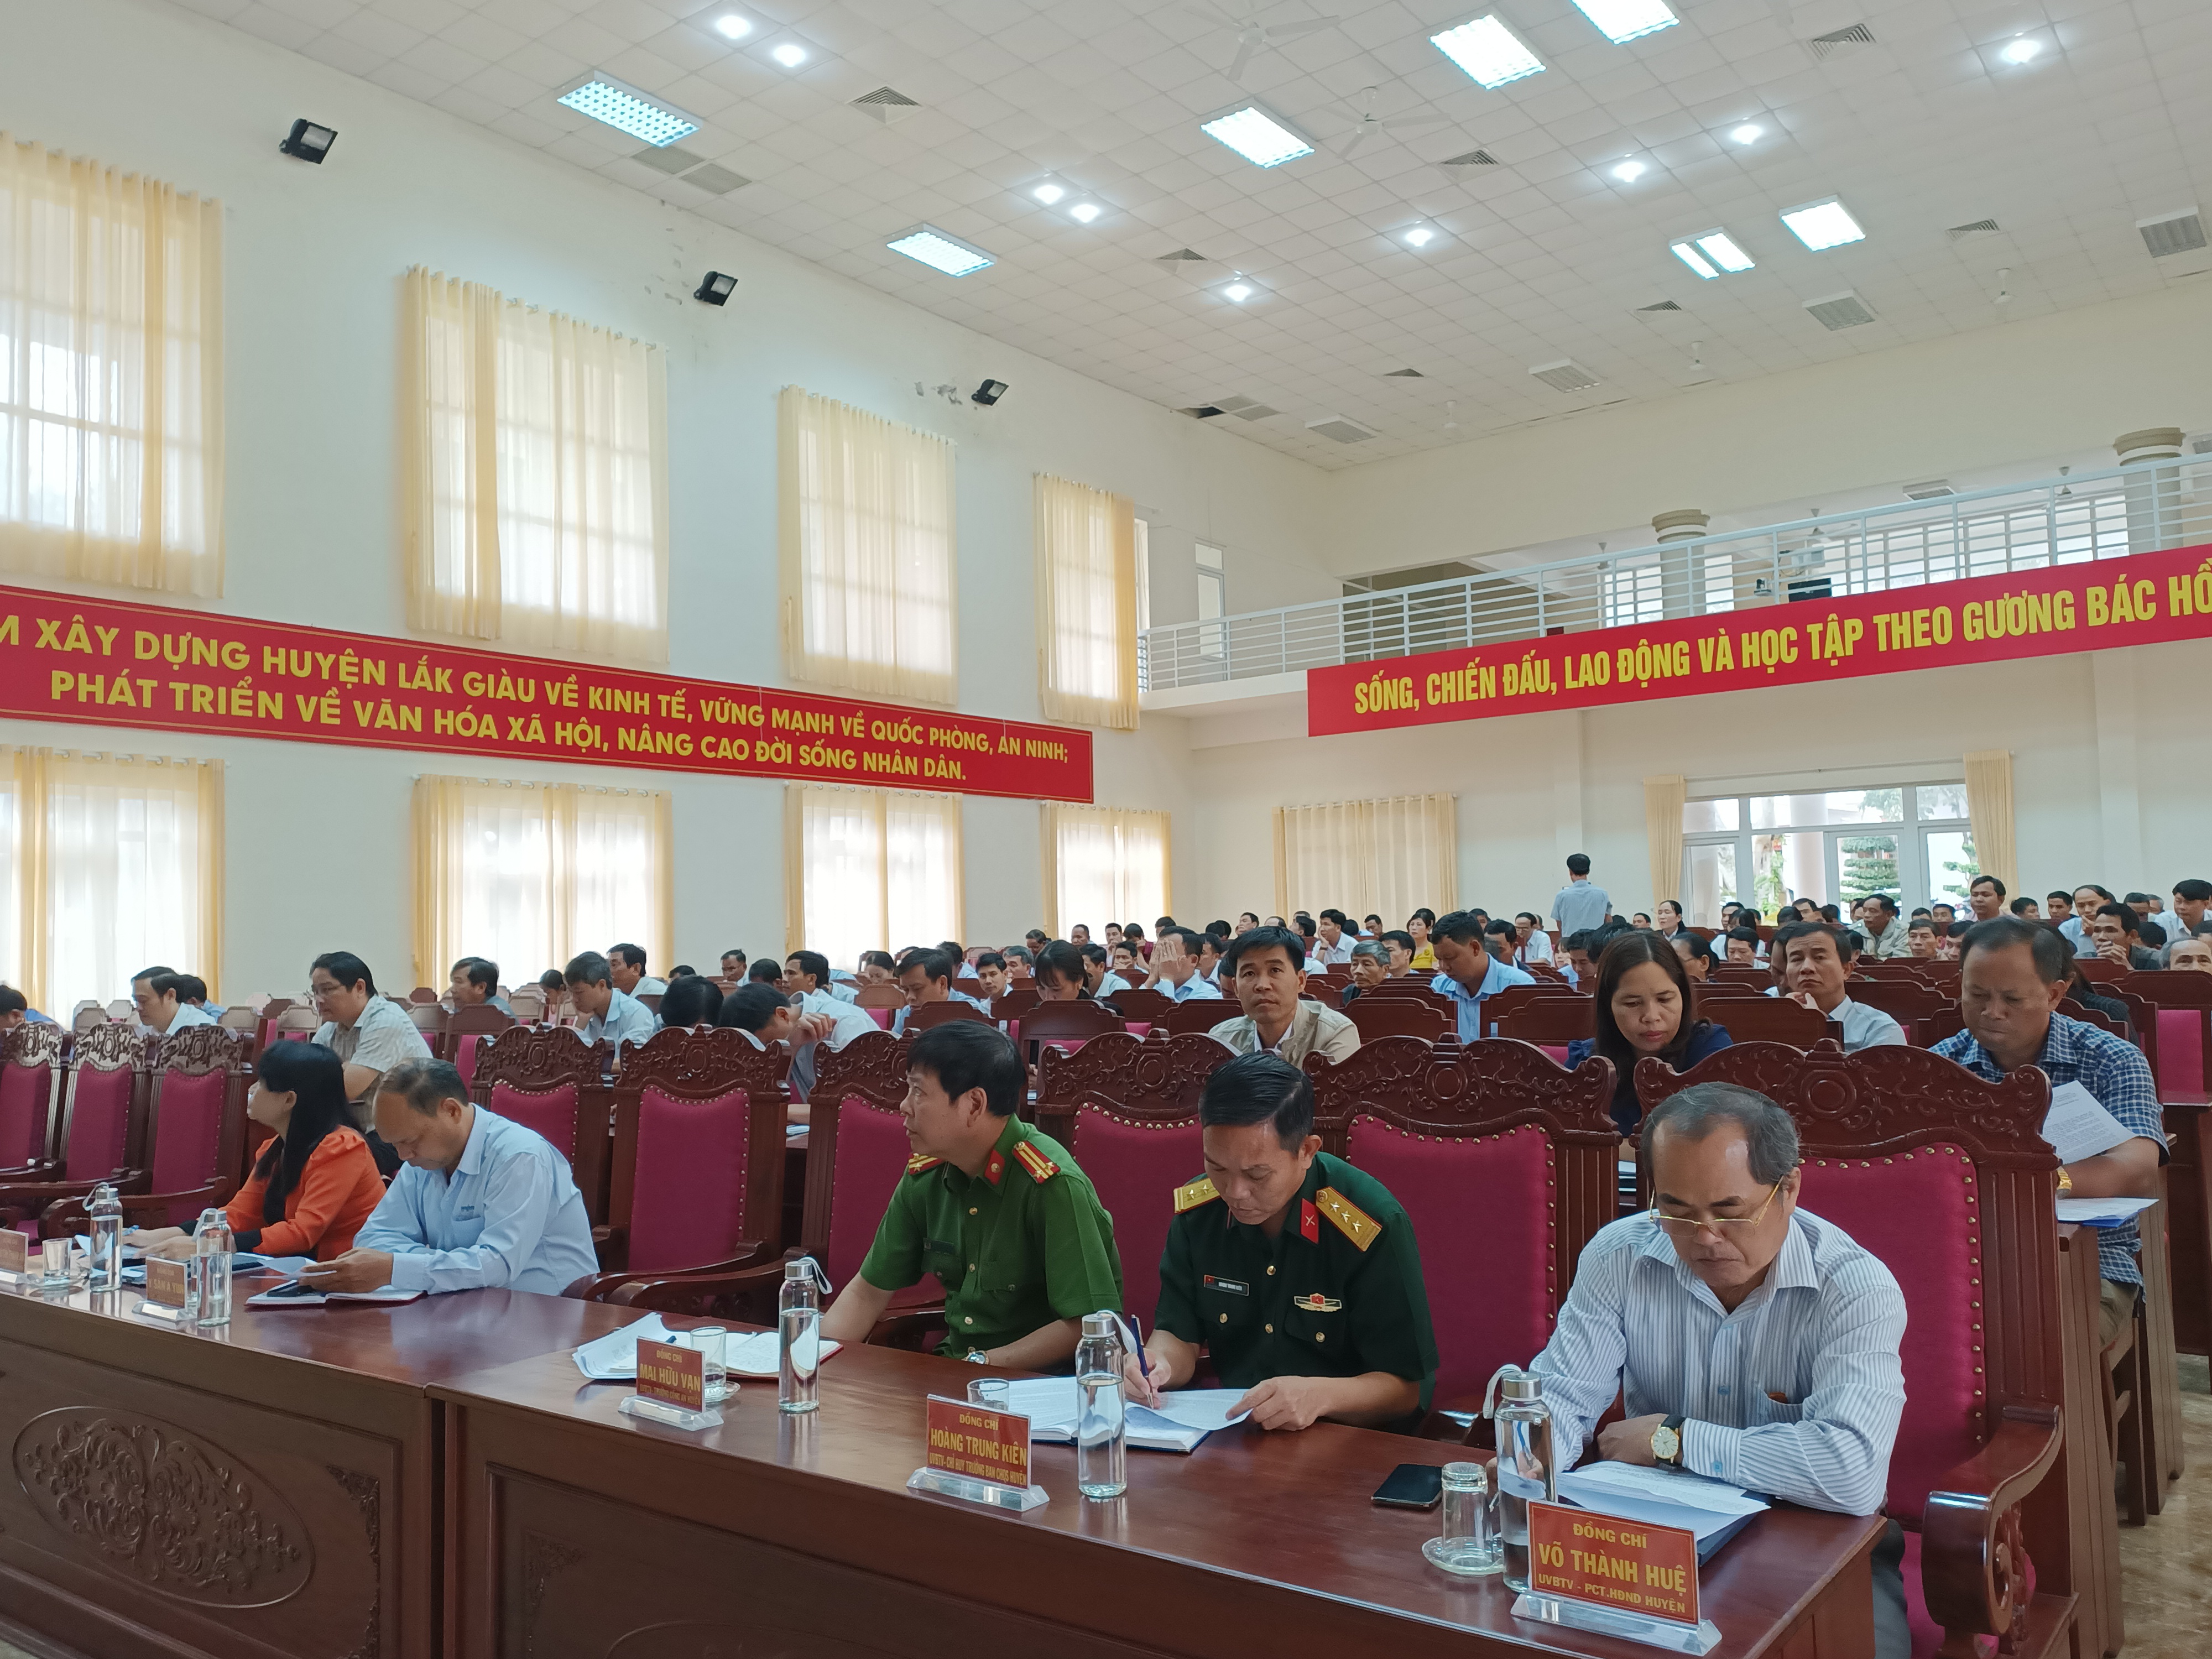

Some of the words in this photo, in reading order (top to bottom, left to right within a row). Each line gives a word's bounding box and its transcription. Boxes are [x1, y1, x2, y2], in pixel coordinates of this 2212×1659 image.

[1355, 671, 1419, 713] SỐNG,
[1427, 658, 1495, 705] CHIẾN
[1503, 650, 1557, 696] ĐẤU,
[1565, 651, 1610, 688] LAO
[1617, 639, 1689, 687] ĐỘNG
[1698, 629, 1734, 672] VÀ
[1741, 627, 1798, 673] HỌC
[1807, 614, 1863, 666] TẬP
[1873, 606, 1952, 651] THEO
[1963, 591, 2075, 641] GƯƠNG
[2086, 575, 2156, 626] BÁC
[2168, 557, 2212, 617] HỒ
[35, 614, 119, 656] XÂY
[135, 632, 249, 670] DỰNG
[264, 646, 385, 689] HUYỆN
[399, 656, 452, 693] LẮK
[463, 668, 535, 702] GIÀU
[545, 675, 578, 707] VỀ
[589, 687, 649, 714] KINH
[658, 688, 692, 722] TẾ,
[700, 697, 764, 726] VỮNG
[772, 708, 834, 737] MẠNH
[841, 712, 864, 737] VỀ
[872, 717, 924, 744] QUỐC
[930, 724, 993, 755] PHÒNG,
[998, 736, 1020, 755] AN
[1025, 739, 1068, 763] NINH;
[52, 669, 158, 708] PHÁT
[169, 676, 285, 720] TRIỂN
[296, 688, 340, 724] VỀ
[353, 699, 421, 732] VĂN
[435, 705, 498, 739] HÓA
[508, 714, 545, 743] XÃ
[555, 717, 608, 752] HỘI,
[618, 724, 693, 755] NÂNG
[701, 736, 749, 760] CAO
[754, 737, 792, 764] ĐỜI
[800, 739, 856, 770] SỐNG
[864, 749, 917, 775] NHÂN
[925, 754, 966, 780] DÂN.
[640, 1363, 656, 1381] MAI
[659, 1366, 678, 1386] HỮU
[681, 1373, 701, 1393] VẠN
[959, 1411, 982, 1427] ĐỒNG
[984, 1418, 999, 1431] CHÍ
[931, 1426, 963, 1452] HOÀNG
[966, 1436, 999, 1460] TRUNG
[1001, 1441, 1027, 1467] KIÊN
[985, 1465, 995, 1478] BAN
[1573, 1521, 1615, 1543] ĐỒNG
[1620, 1532, 1647, 1549] CHÍ
[1538, 1541, 1564, 1568] VÕ
[1571, 1549, 1638, 1583] THÀNH
[1645, 1564, 1687, 1597] HUỆ
[1538, 1573, 1574, 1590] UVBTV
[1645, 1595, 1686, 1614] HUYỆN
